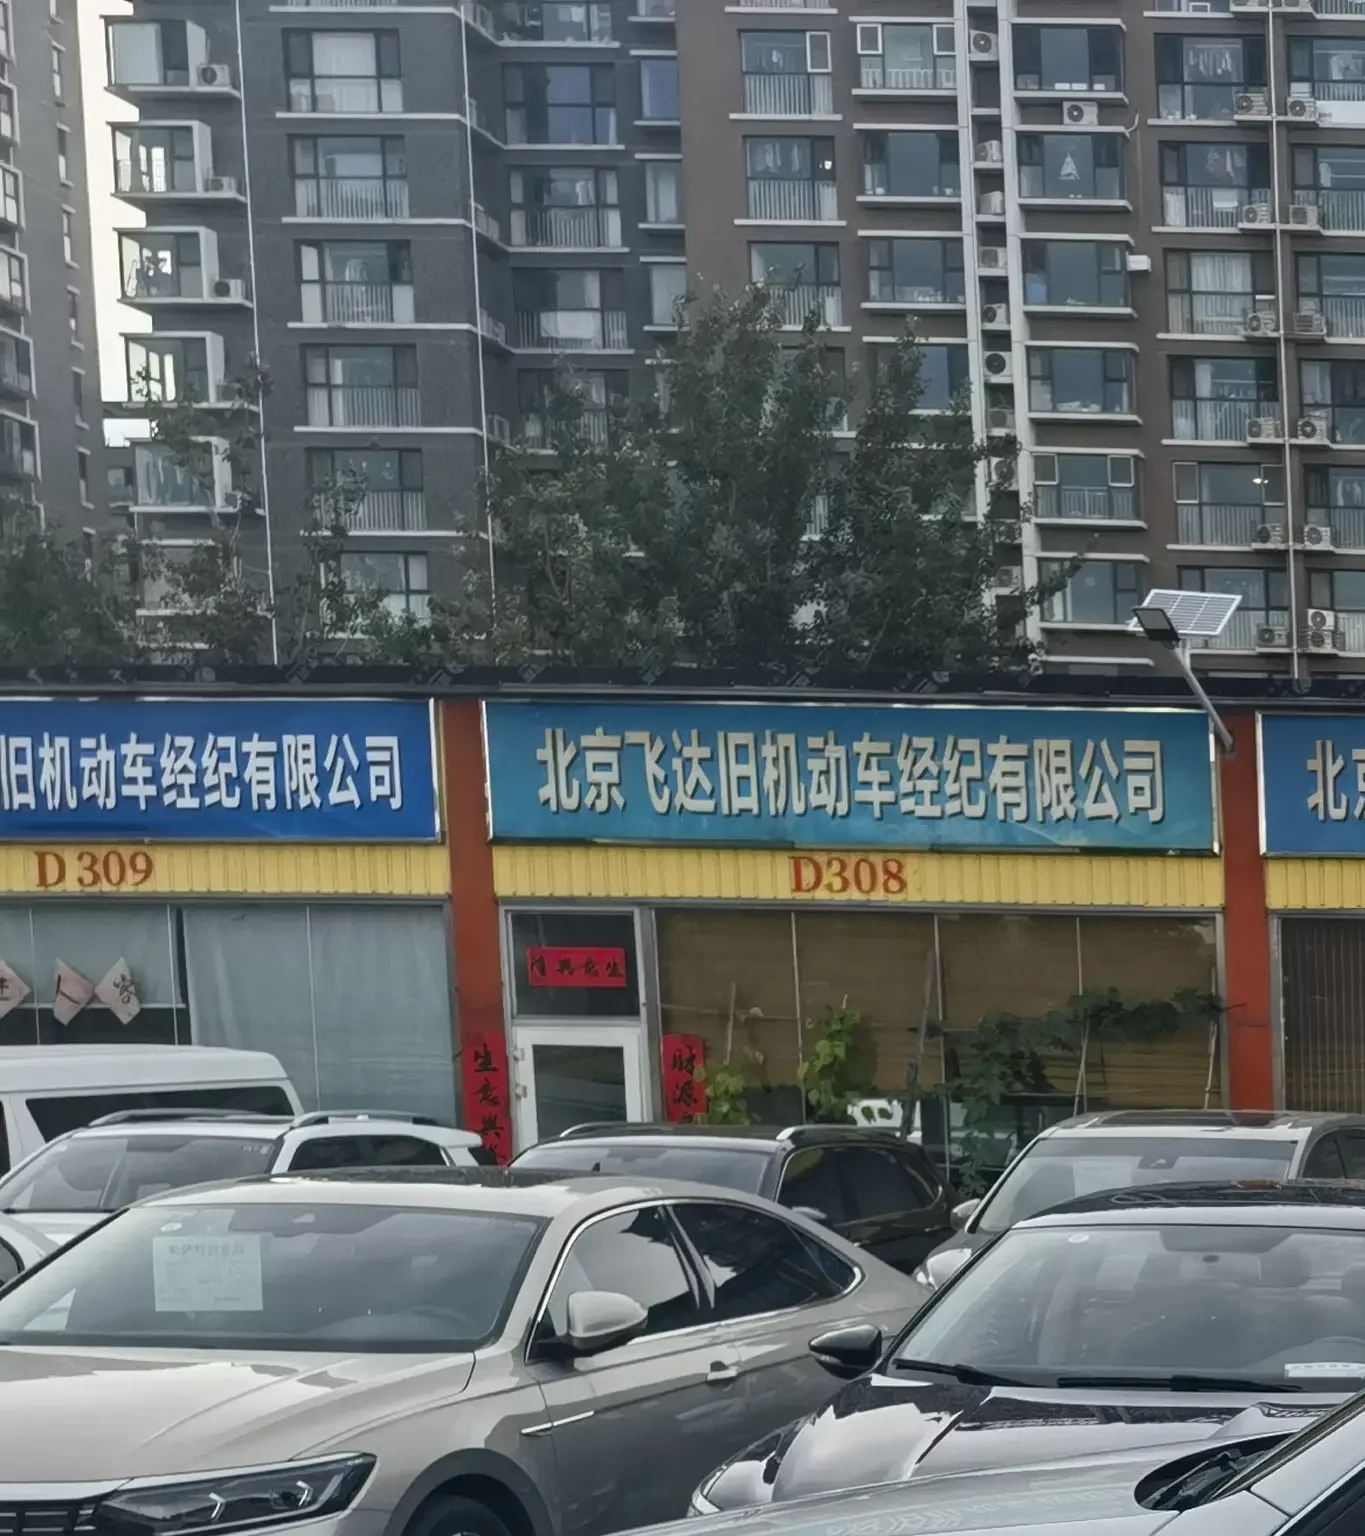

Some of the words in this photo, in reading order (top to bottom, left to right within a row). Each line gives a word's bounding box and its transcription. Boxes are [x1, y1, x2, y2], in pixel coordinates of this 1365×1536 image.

[0, 732, 404, 810] 旧机动车经纪有限公司
[536, 727, 1165, 823] 北京飞达旧机动车经纪有限公司
[790, 855, 908, 894] D308
